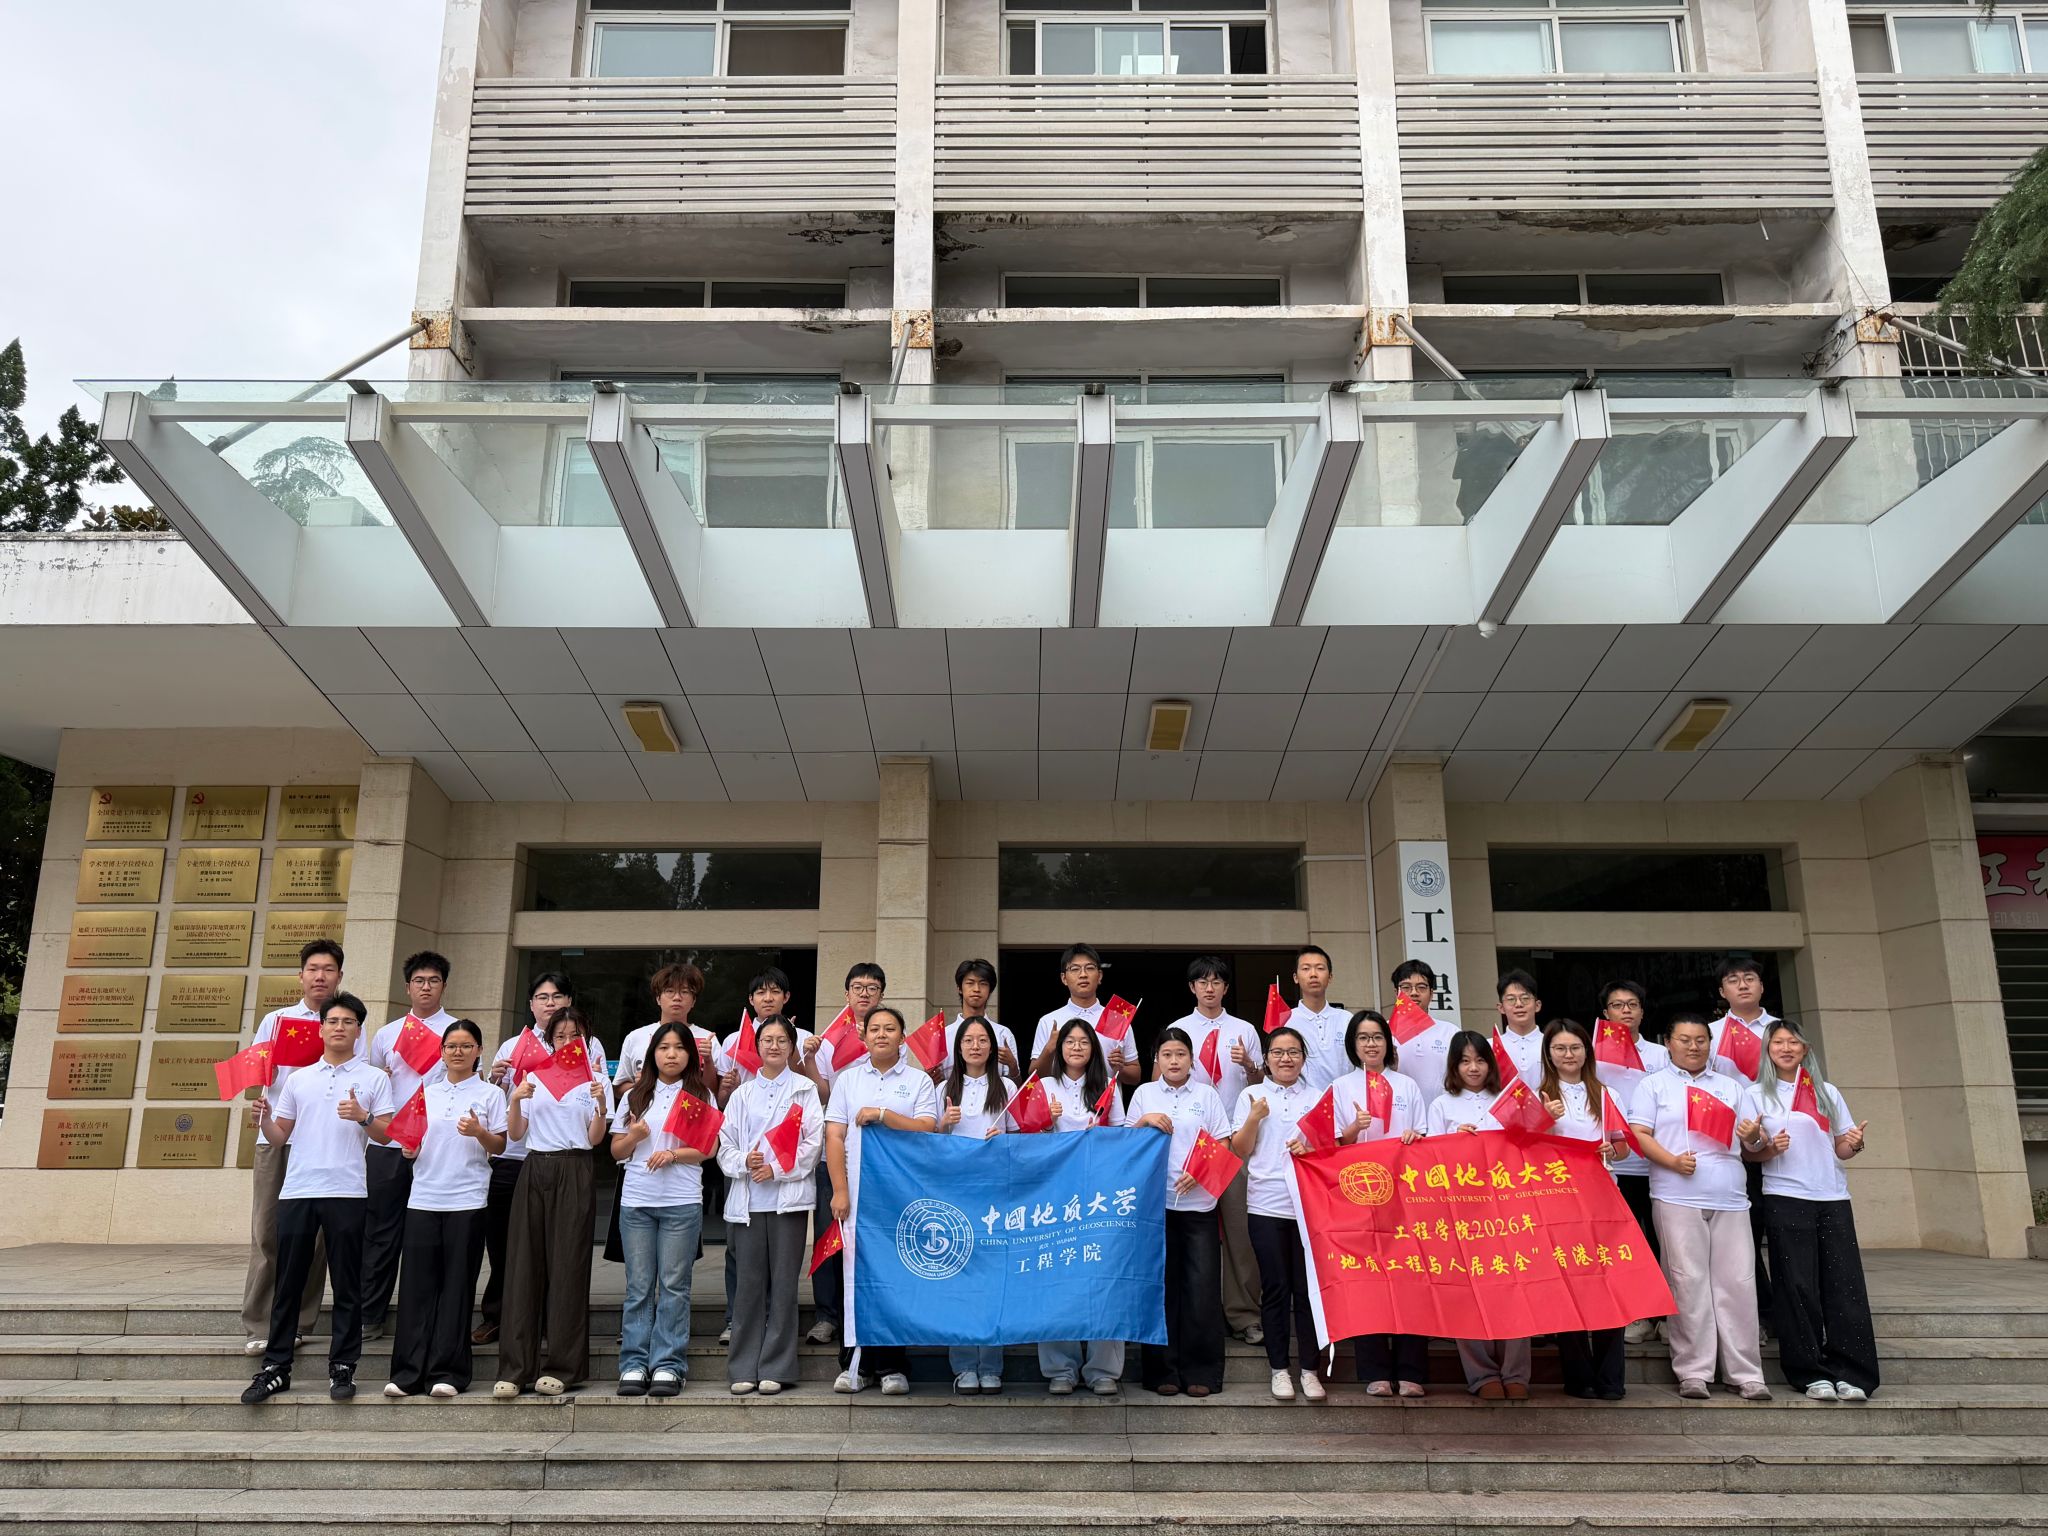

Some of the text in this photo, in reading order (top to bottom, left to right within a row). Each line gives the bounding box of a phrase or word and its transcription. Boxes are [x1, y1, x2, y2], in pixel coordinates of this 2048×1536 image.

[152, 1134, 212, 1143] 全国科普教育基地
[1405, 1187, 1579, 1204] CHINA UNIVERSITY OF GEOSCIENCES
[980, 1220, 1137, 1246] CHINA UNIVERSITY OF GEOSCIENCES
[1394, 1214, 1537, 1242] 工程学院2026年
[1014, 1243, 1102, 1274] 工程学院
[1552, 1243, 1633, 1270] 香港实习
